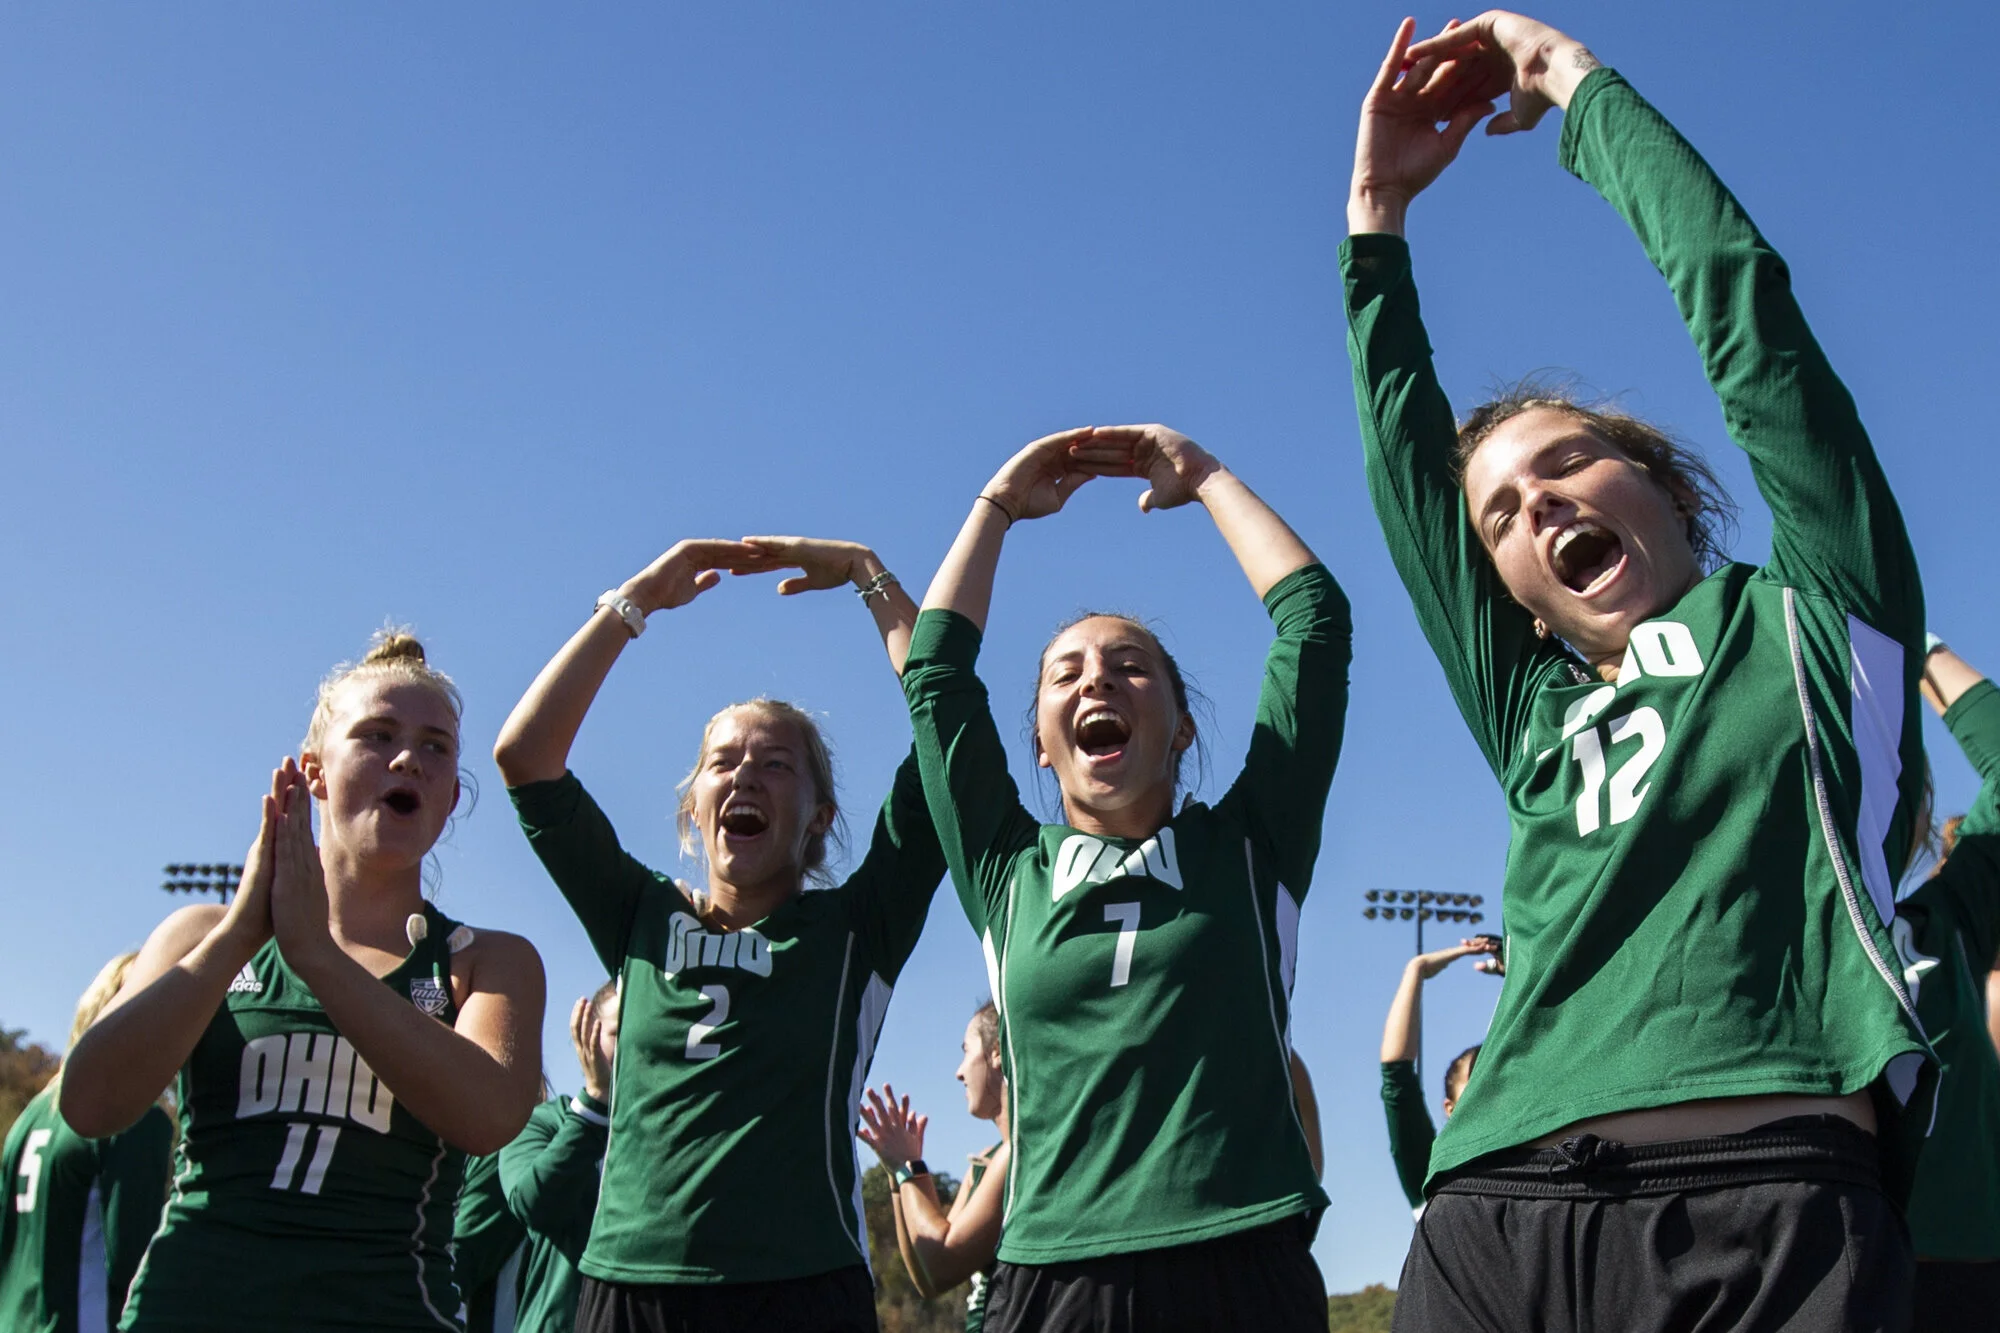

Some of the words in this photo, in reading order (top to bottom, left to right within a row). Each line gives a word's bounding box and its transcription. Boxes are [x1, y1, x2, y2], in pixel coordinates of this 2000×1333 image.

[1573, 706, 1666, 837] 12
[1104, 902, 1141, 987] 7
[684, 984, 730, 1059] 2
[235, 1032, 394, 1134] OHIO
[16, 1129, 53, 1213] 5
[269, 1123, 341, 1195] 11
